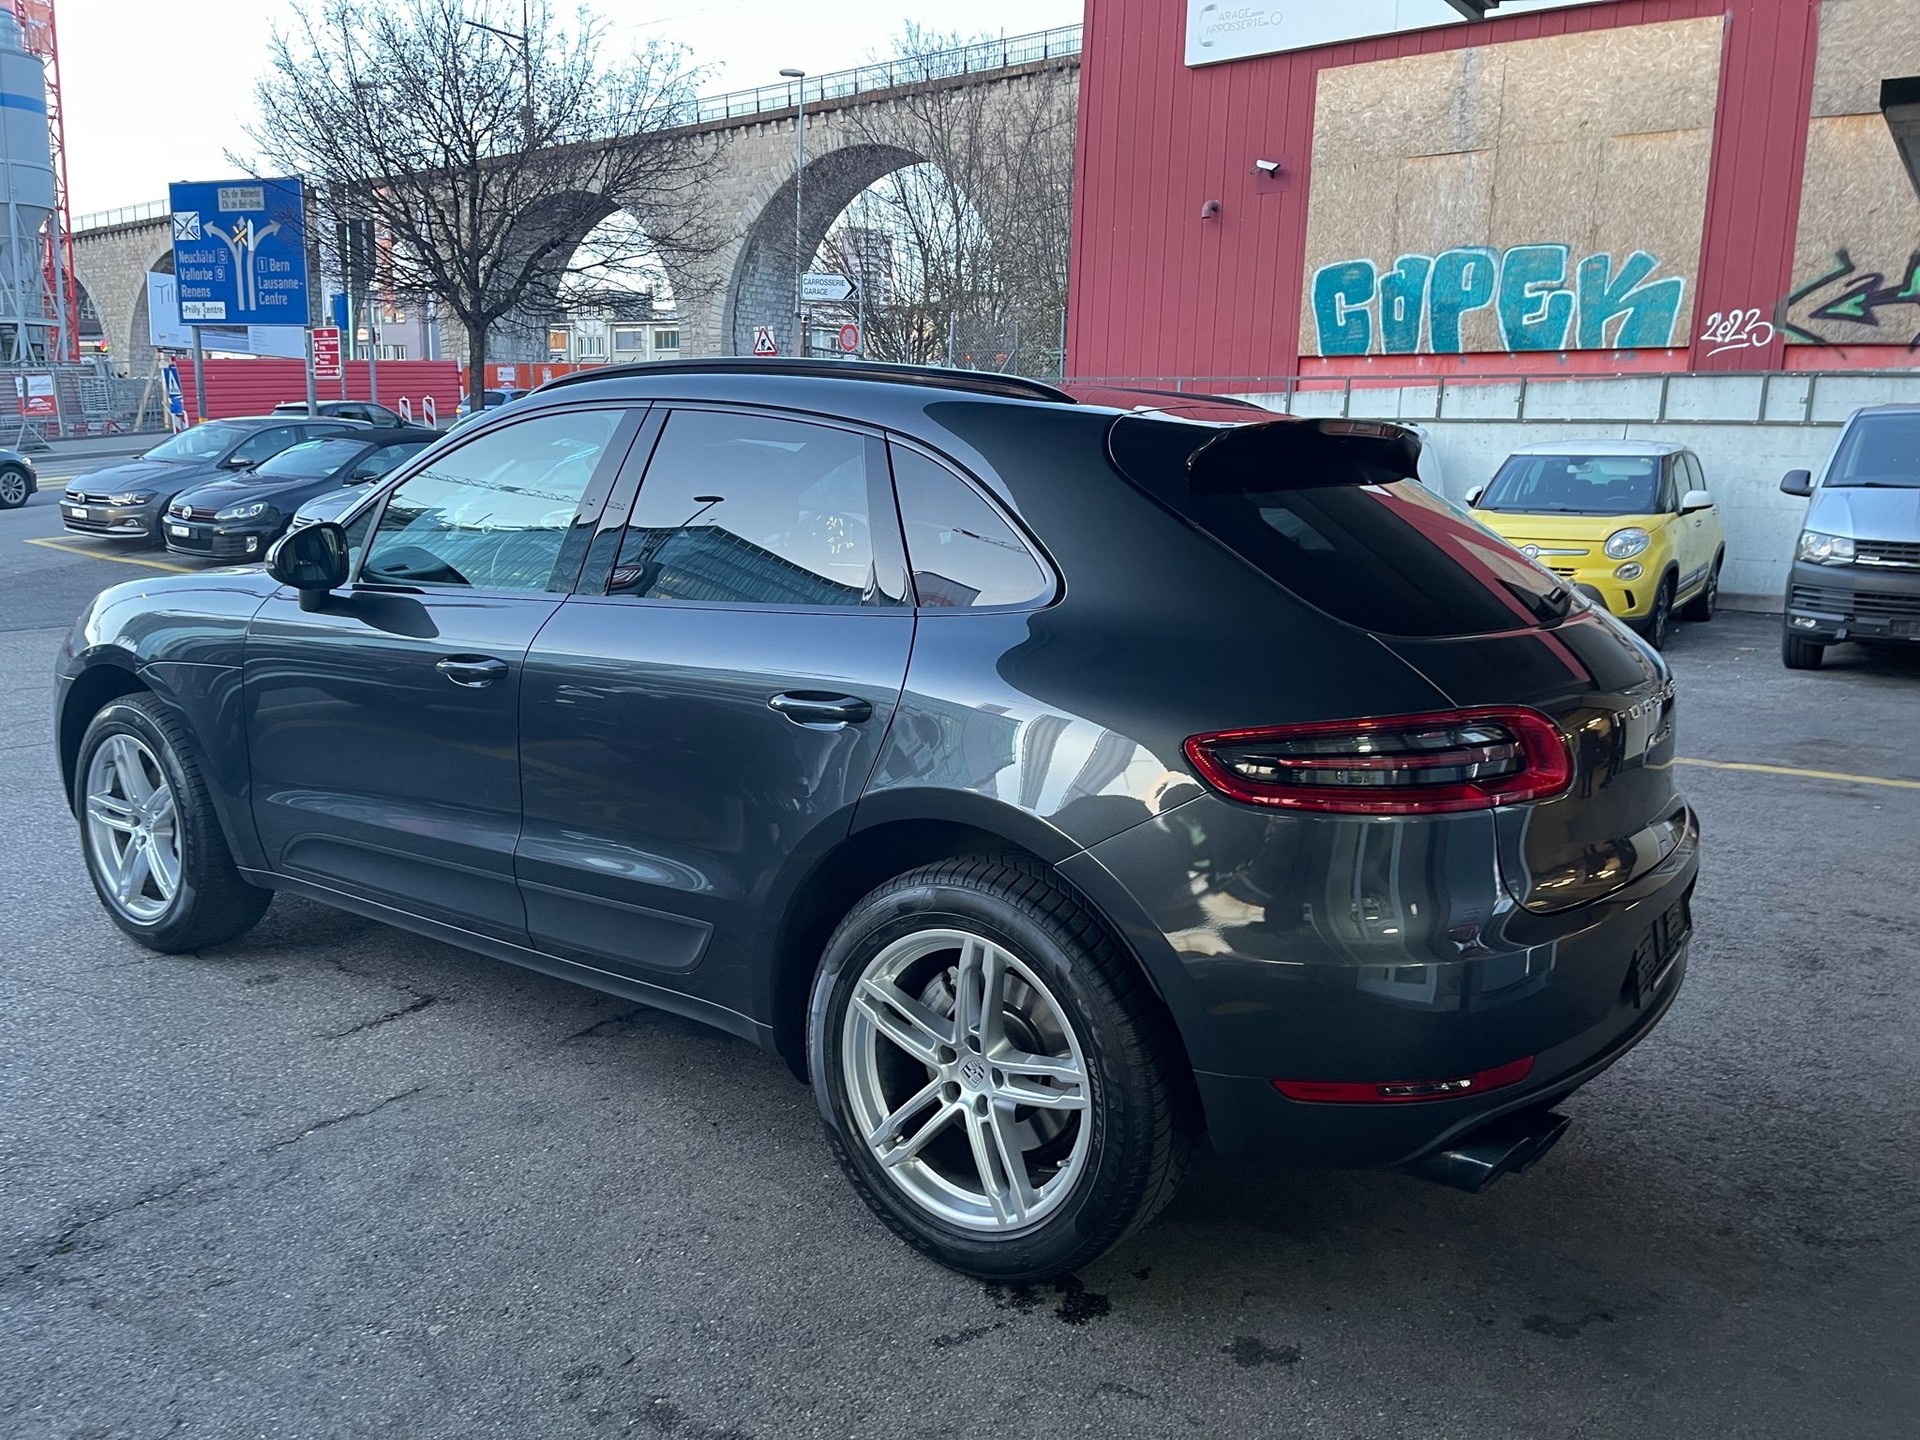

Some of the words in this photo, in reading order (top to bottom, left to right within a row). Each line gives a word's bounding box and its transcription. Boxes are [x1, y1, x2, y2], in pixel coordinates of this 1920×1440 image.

[178, 250, 216, 264] Neuchâtel
[269, 258, 290, 272] Bern
[179, 267, 213, 281] Vallorbe
[803, 278, 845, 287] CARROSSERIE
[181, 285, 211, 298] Renens
[803, 288, 829, 296] GARAGE
[259, 292, 288, 305] Centre
[184, 304, 200, 316] Prilly
[203, 305, 223, 314] centre
